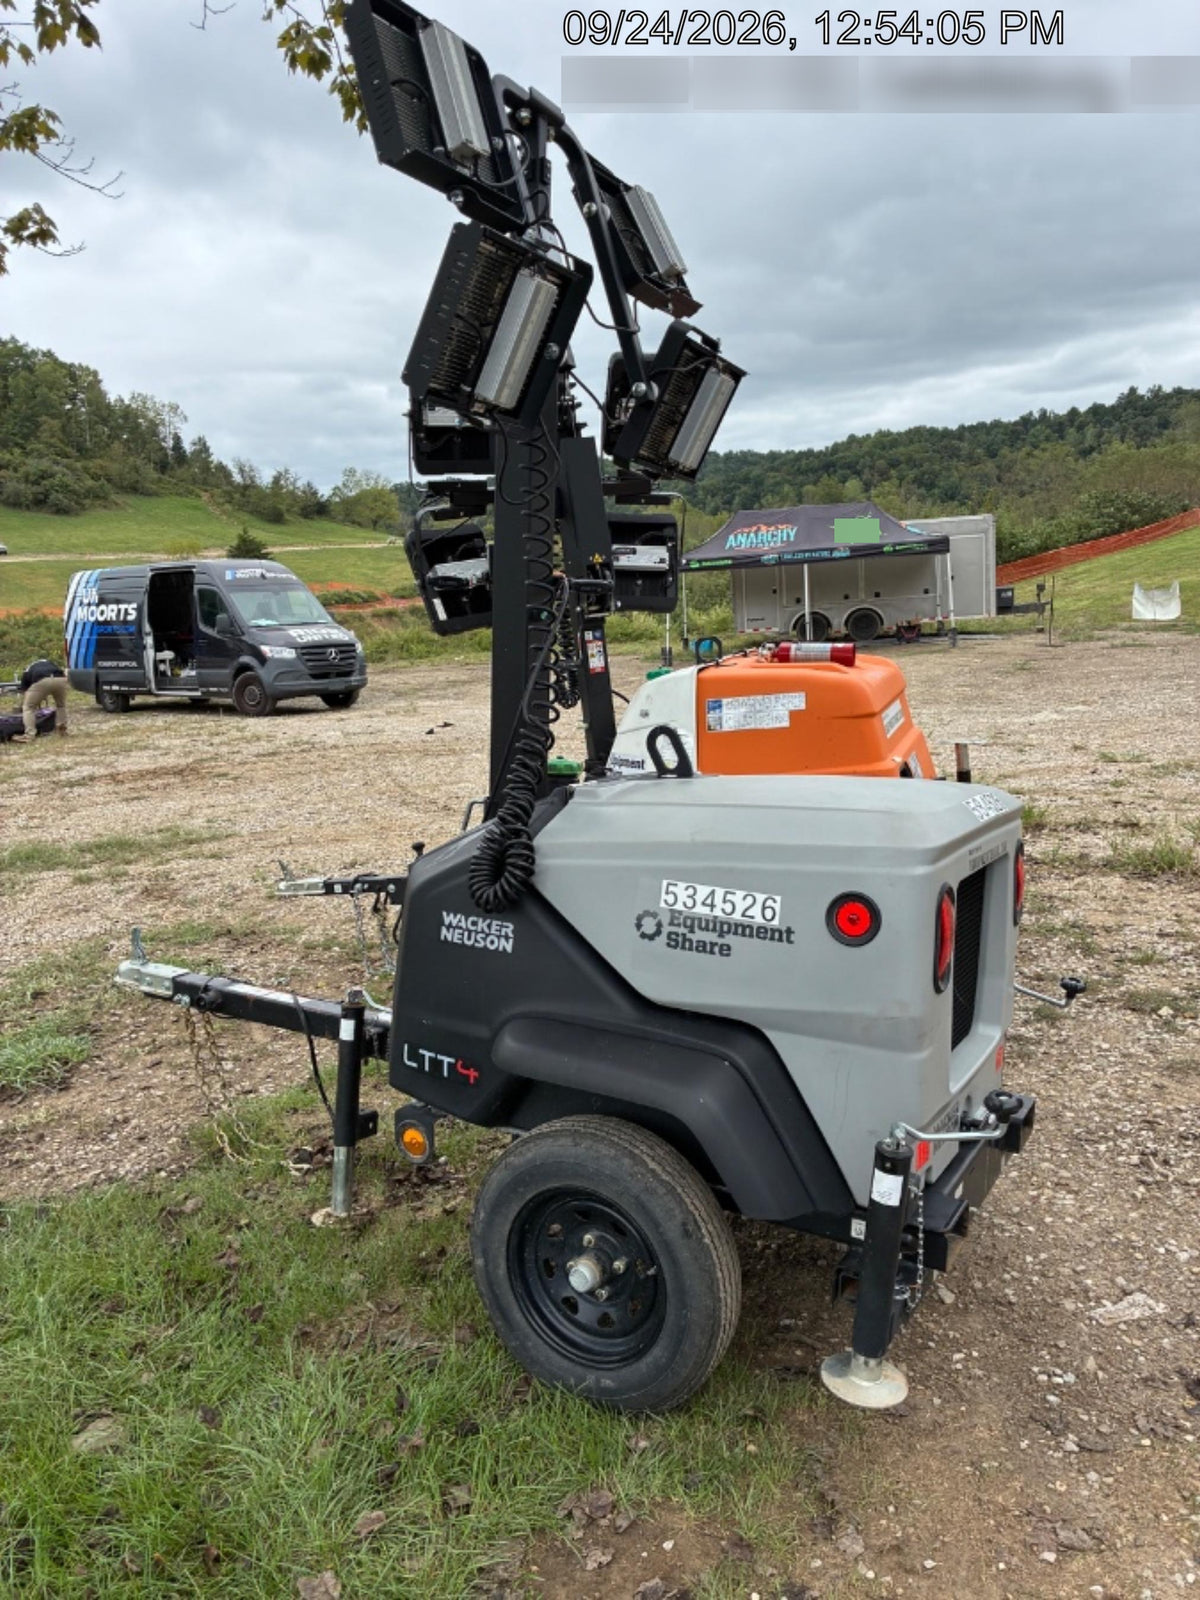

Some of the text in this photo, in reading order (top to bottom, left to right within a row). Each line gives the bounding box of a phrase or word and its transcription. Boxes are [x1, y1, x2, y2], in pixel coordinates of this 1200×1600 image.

[663, 881, 778, 922] 534526
[440, 926, 514, 953] NEUSON
[441, 911, 515, 937] WACKER
[667, 909, 796, 944] Equipment
[665, 931, 732, 957] Share
[403, 1043, 480, 1085] LTT4
